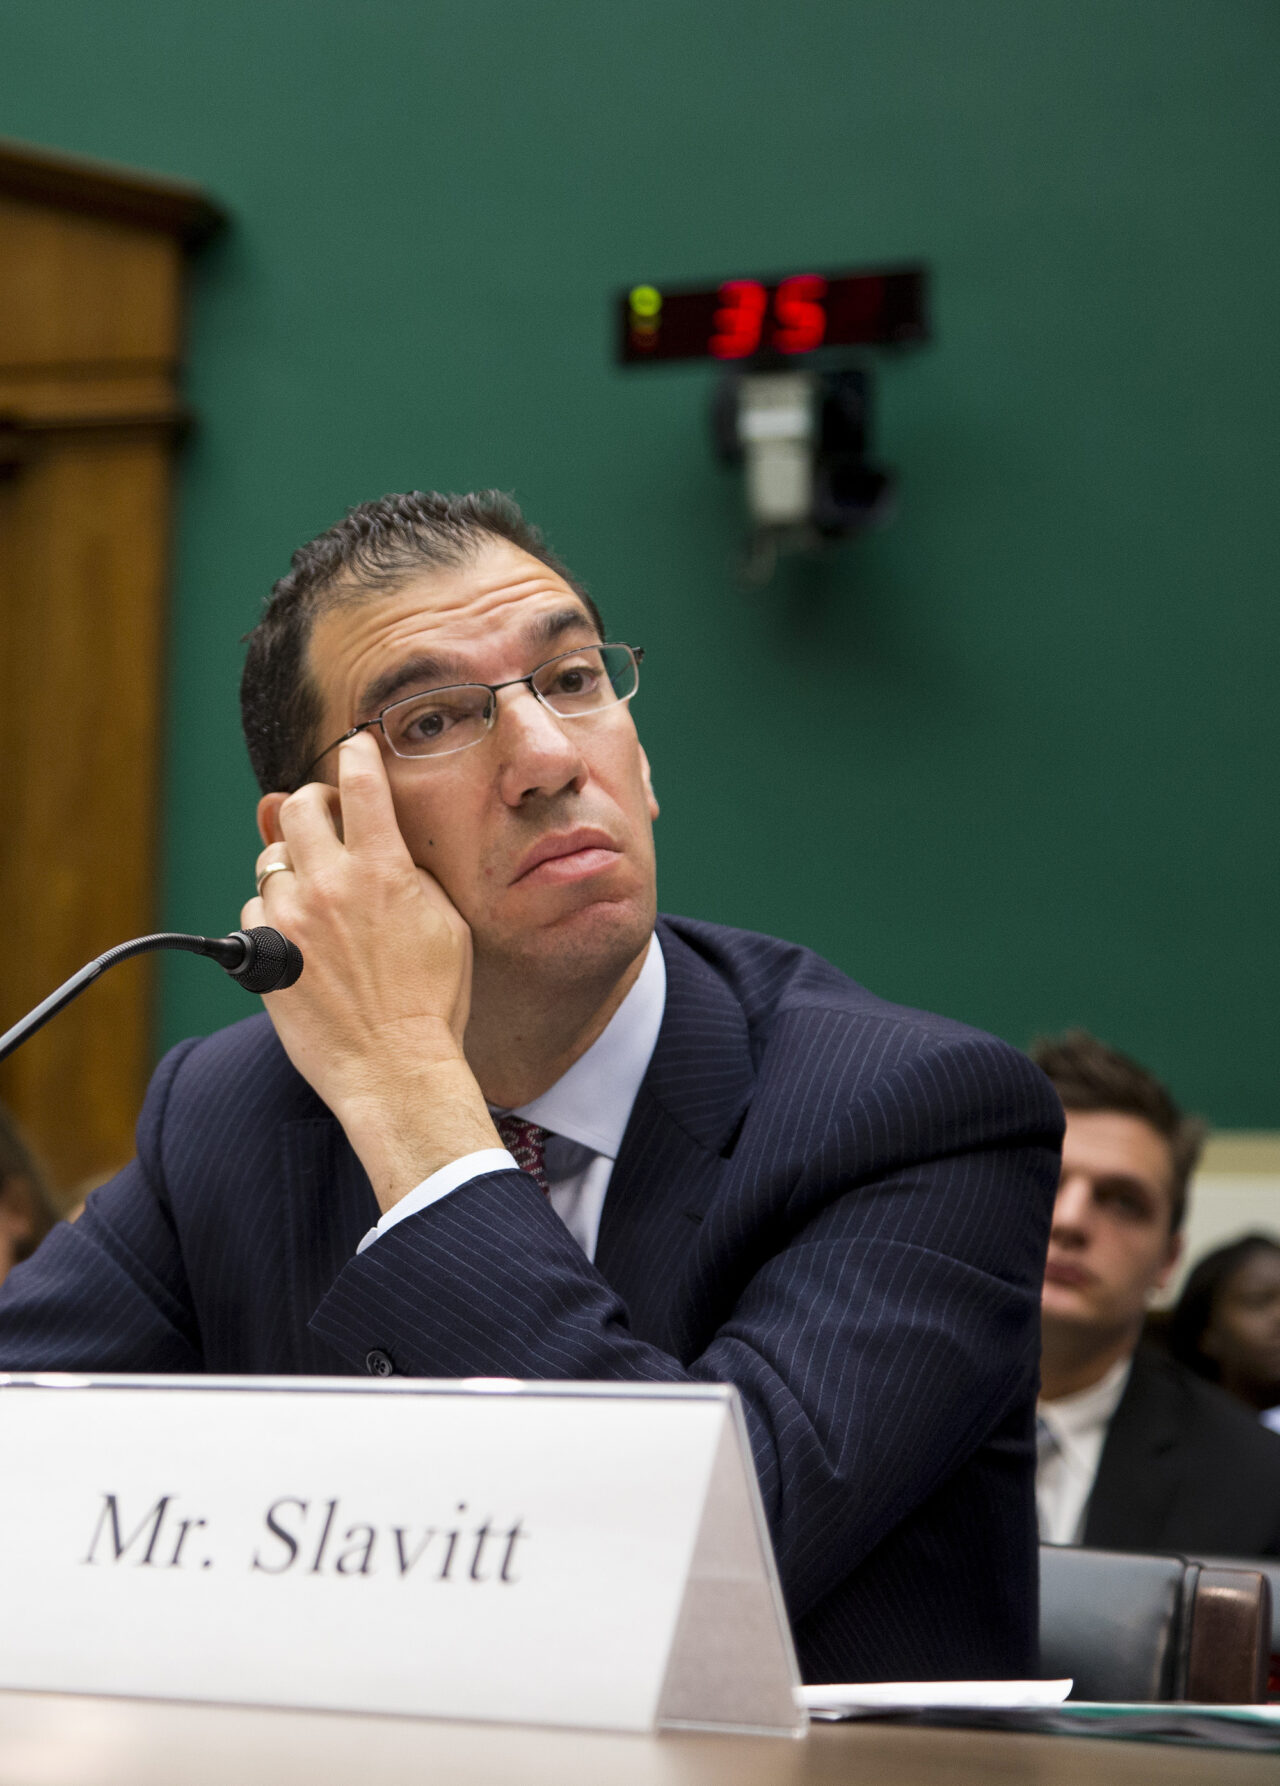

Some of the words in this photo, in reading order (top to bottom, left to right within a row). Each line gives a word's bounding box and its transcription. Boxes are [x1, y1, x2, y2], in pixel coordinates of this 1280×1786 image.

[707, 274, 828, 361] 35
[80, 1492, 214, 1571] Mr.
[250, 1495, 531, 1586] Slavitt
